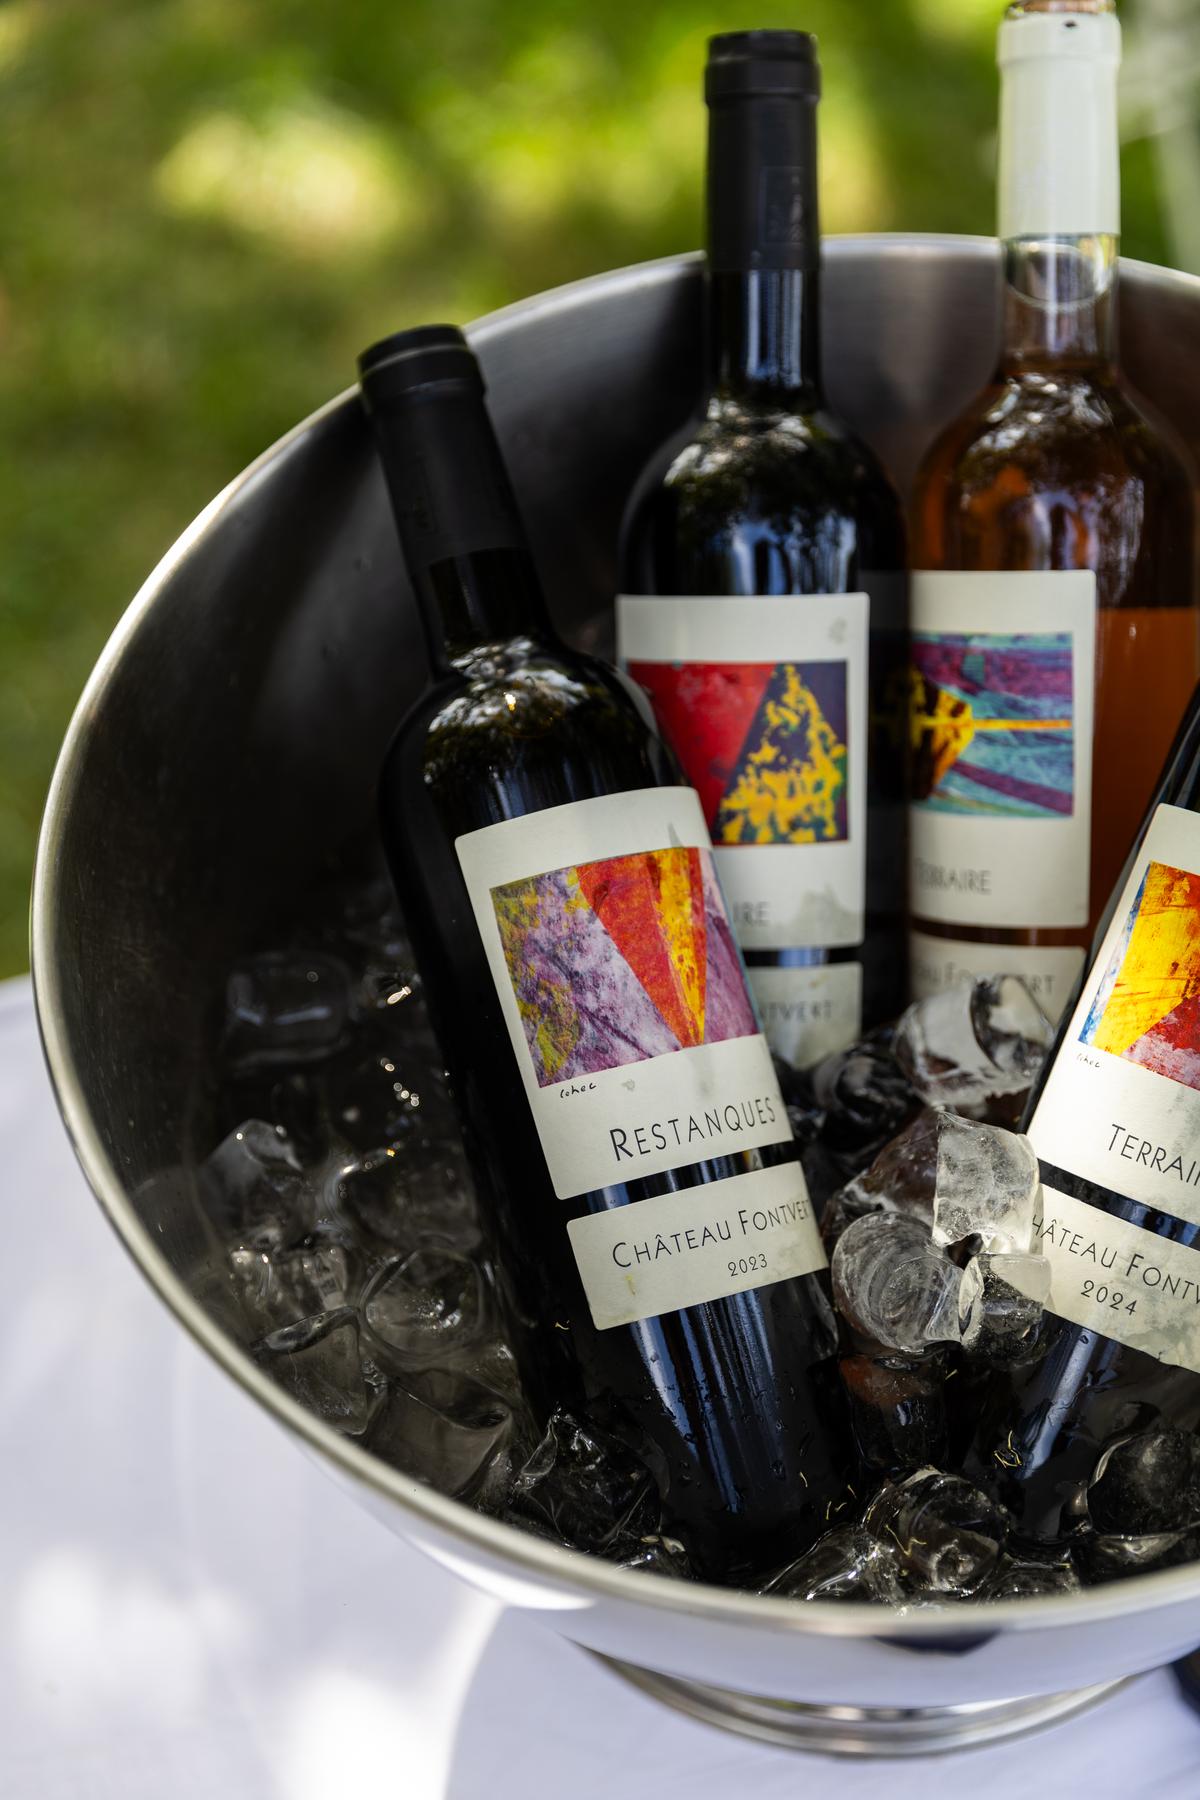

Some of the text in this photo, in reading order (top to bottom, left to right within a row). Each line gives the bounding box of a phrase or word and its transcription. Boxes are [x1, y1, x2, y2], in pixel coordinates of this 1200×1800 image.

[610, 1097, 776, 1161] RESTANQUES
[1108, 1123, 1200, 1186] TERRAI
[612, 1199, 809, 1268] CHÂTEAU FONTVER
[1032, 1214, 1118, 1268] HÂTEAU
[727, 1253, 768, 1277] 2023
[1081, 1280, 1137, 1316] 2024
